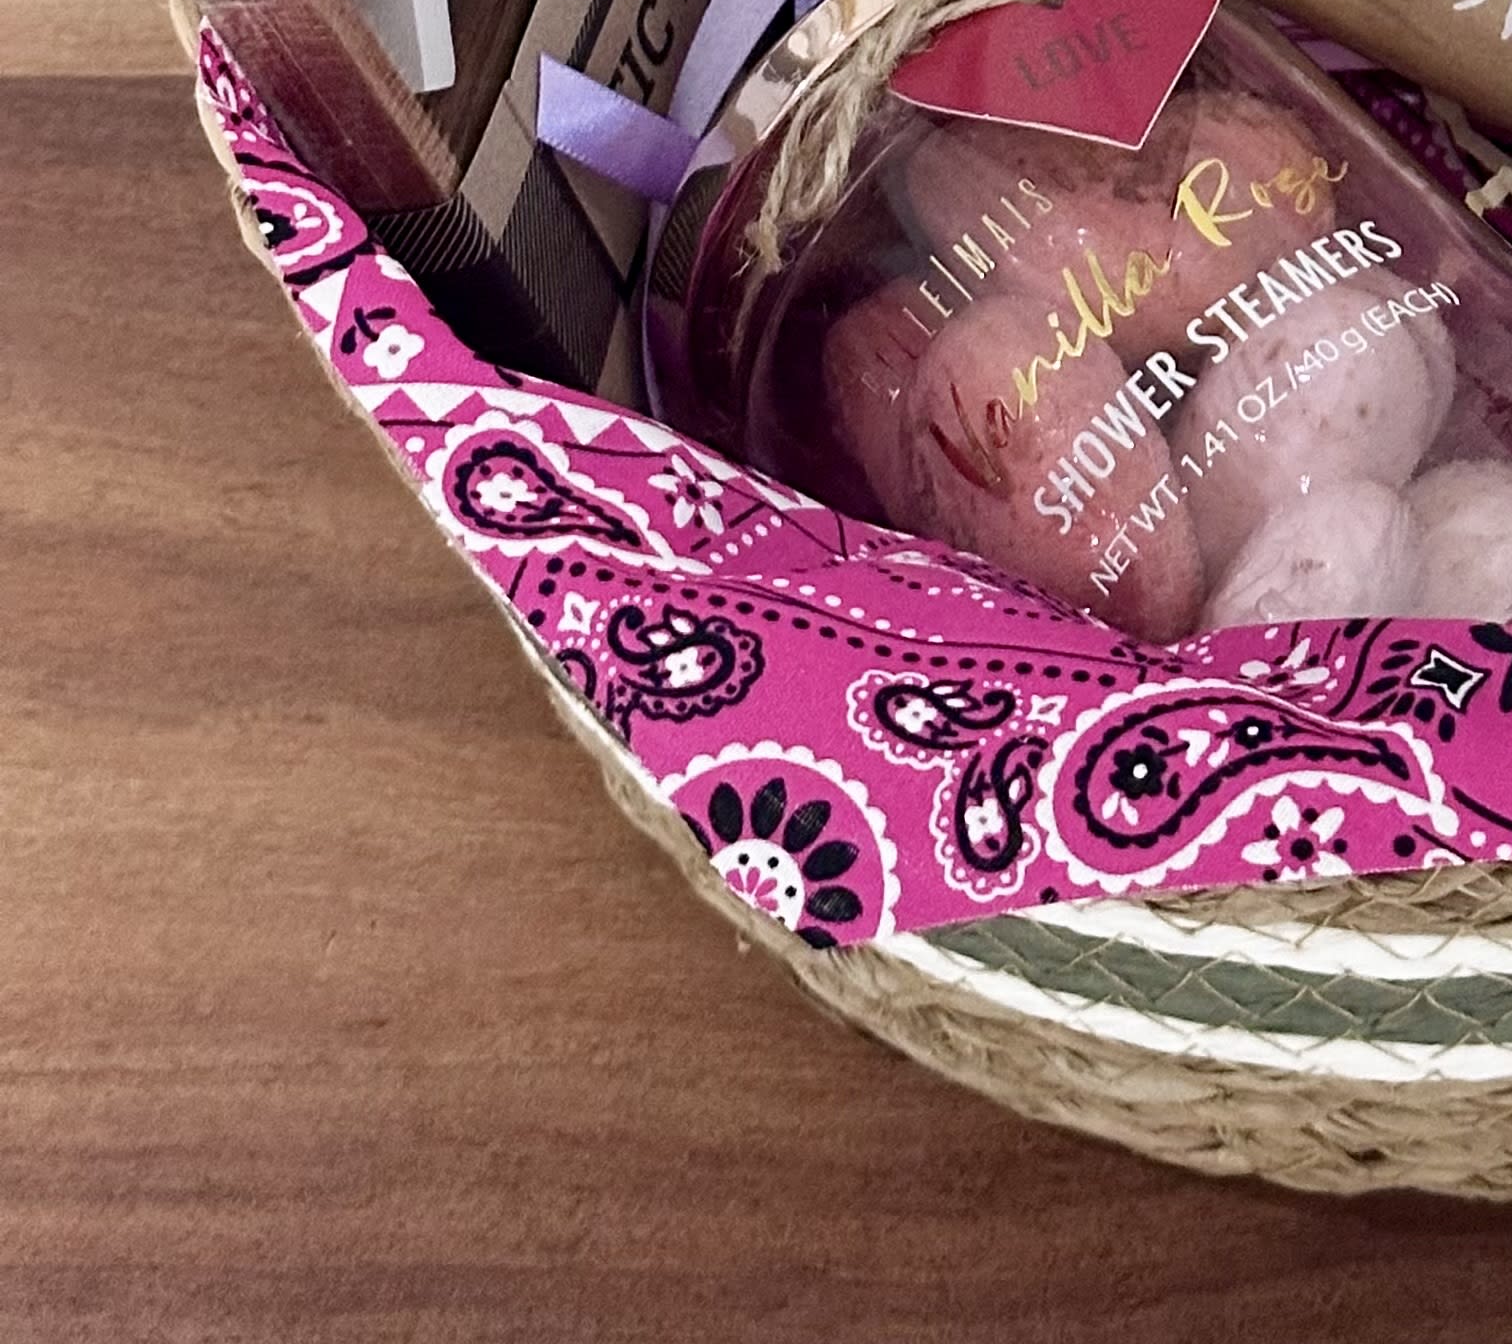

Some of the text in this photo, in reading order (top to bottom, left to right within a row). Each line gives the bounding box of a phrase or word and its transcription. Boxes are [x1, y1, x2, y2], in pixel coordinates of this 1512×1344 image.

[1013, 12, 1147, 90] LOVE
[928, 155, 1348, 492] Vanilla Rose
[1033, 220, 1403, 535] SHOWER STEAMERS
[1089, 524, 1139, 597] NET
[1130, 473, 1188, 534] WT.
[1180, 419, 1240, 478] 1.41
[1237, 376, 1288, 423] OZ
[1342, 326, 1369, 354] g
[1361, 281, 1461, 337] (EACH)
